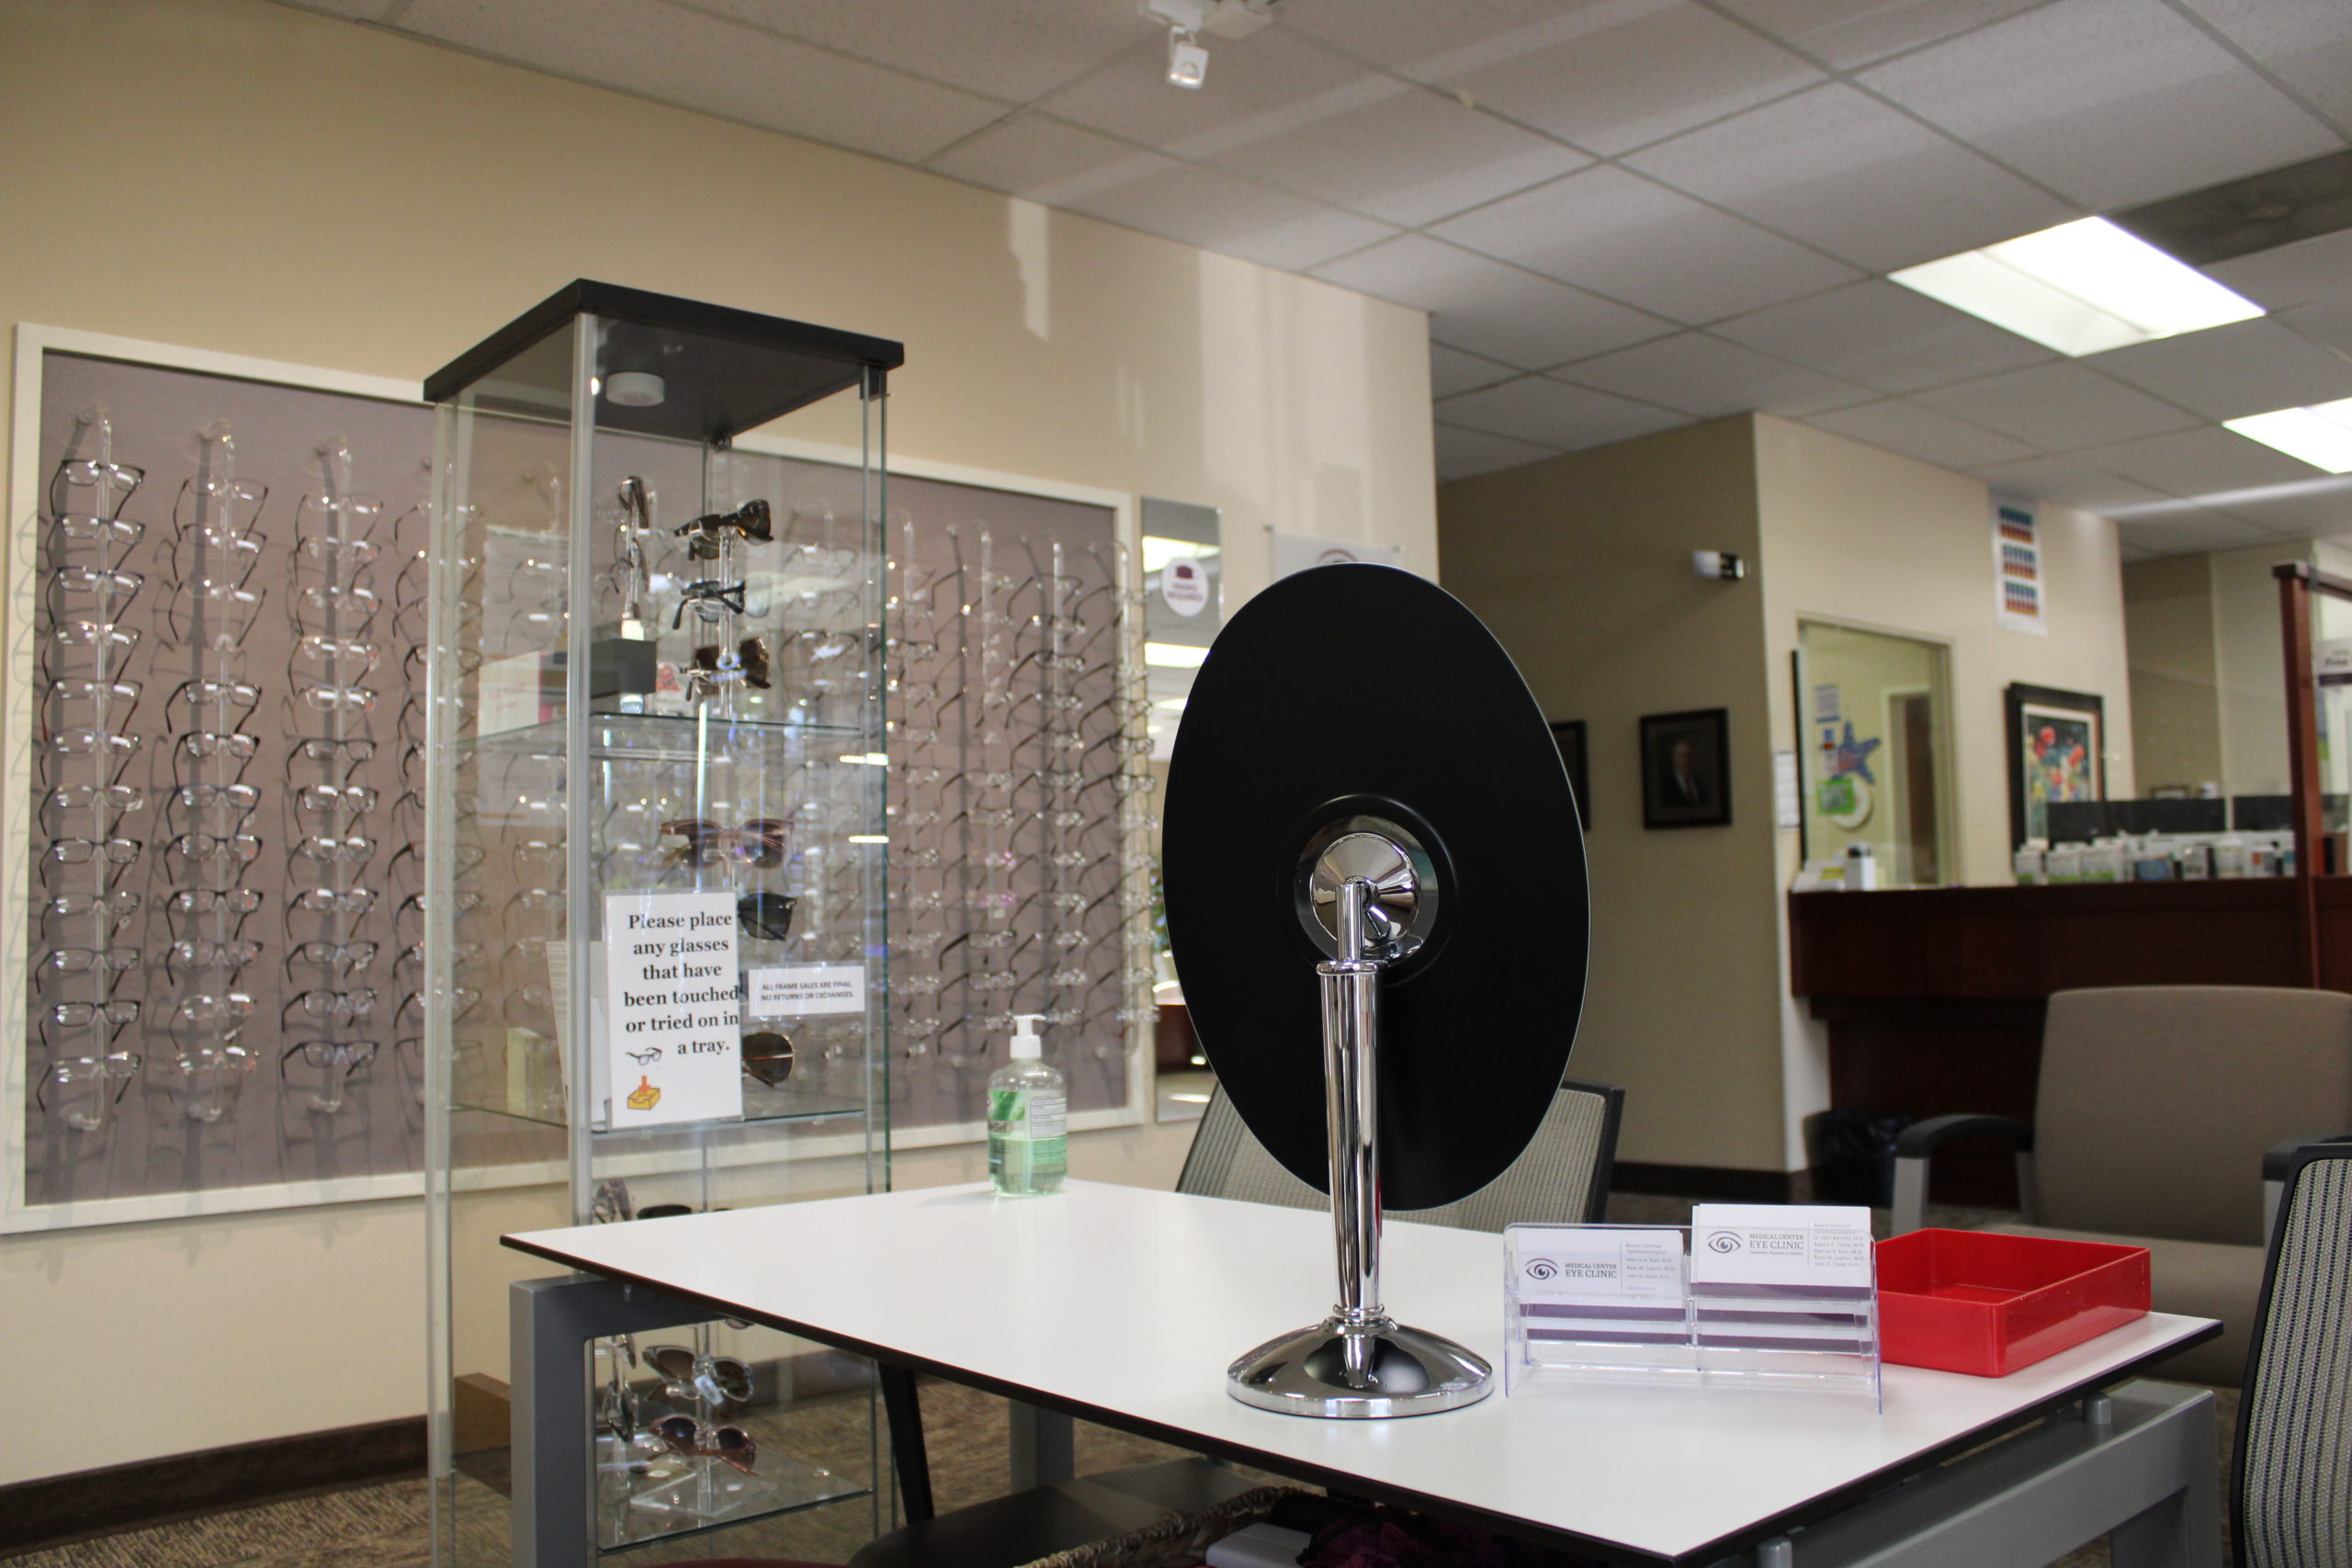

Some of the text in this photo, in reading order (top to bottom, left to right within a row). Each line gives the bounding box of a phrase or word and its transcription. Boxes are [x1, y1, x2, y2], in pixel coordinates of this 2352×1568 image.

[628, 911, 732, 931] Please place
[633, 939, 729, 957] any glasses
[642, 963, 722, 980] that have
[799, 981, 818, 989] SALES
[624, 986, 739, 1007] been touched
[626, 1011, 739, 1033] or tried on in
[677, 1041, 729, 1056] a tray.
[1749, 1240, 1804, 1250] EYE CLINIC
[1566, 1269, 1617, 1279] EYE CLINIC
